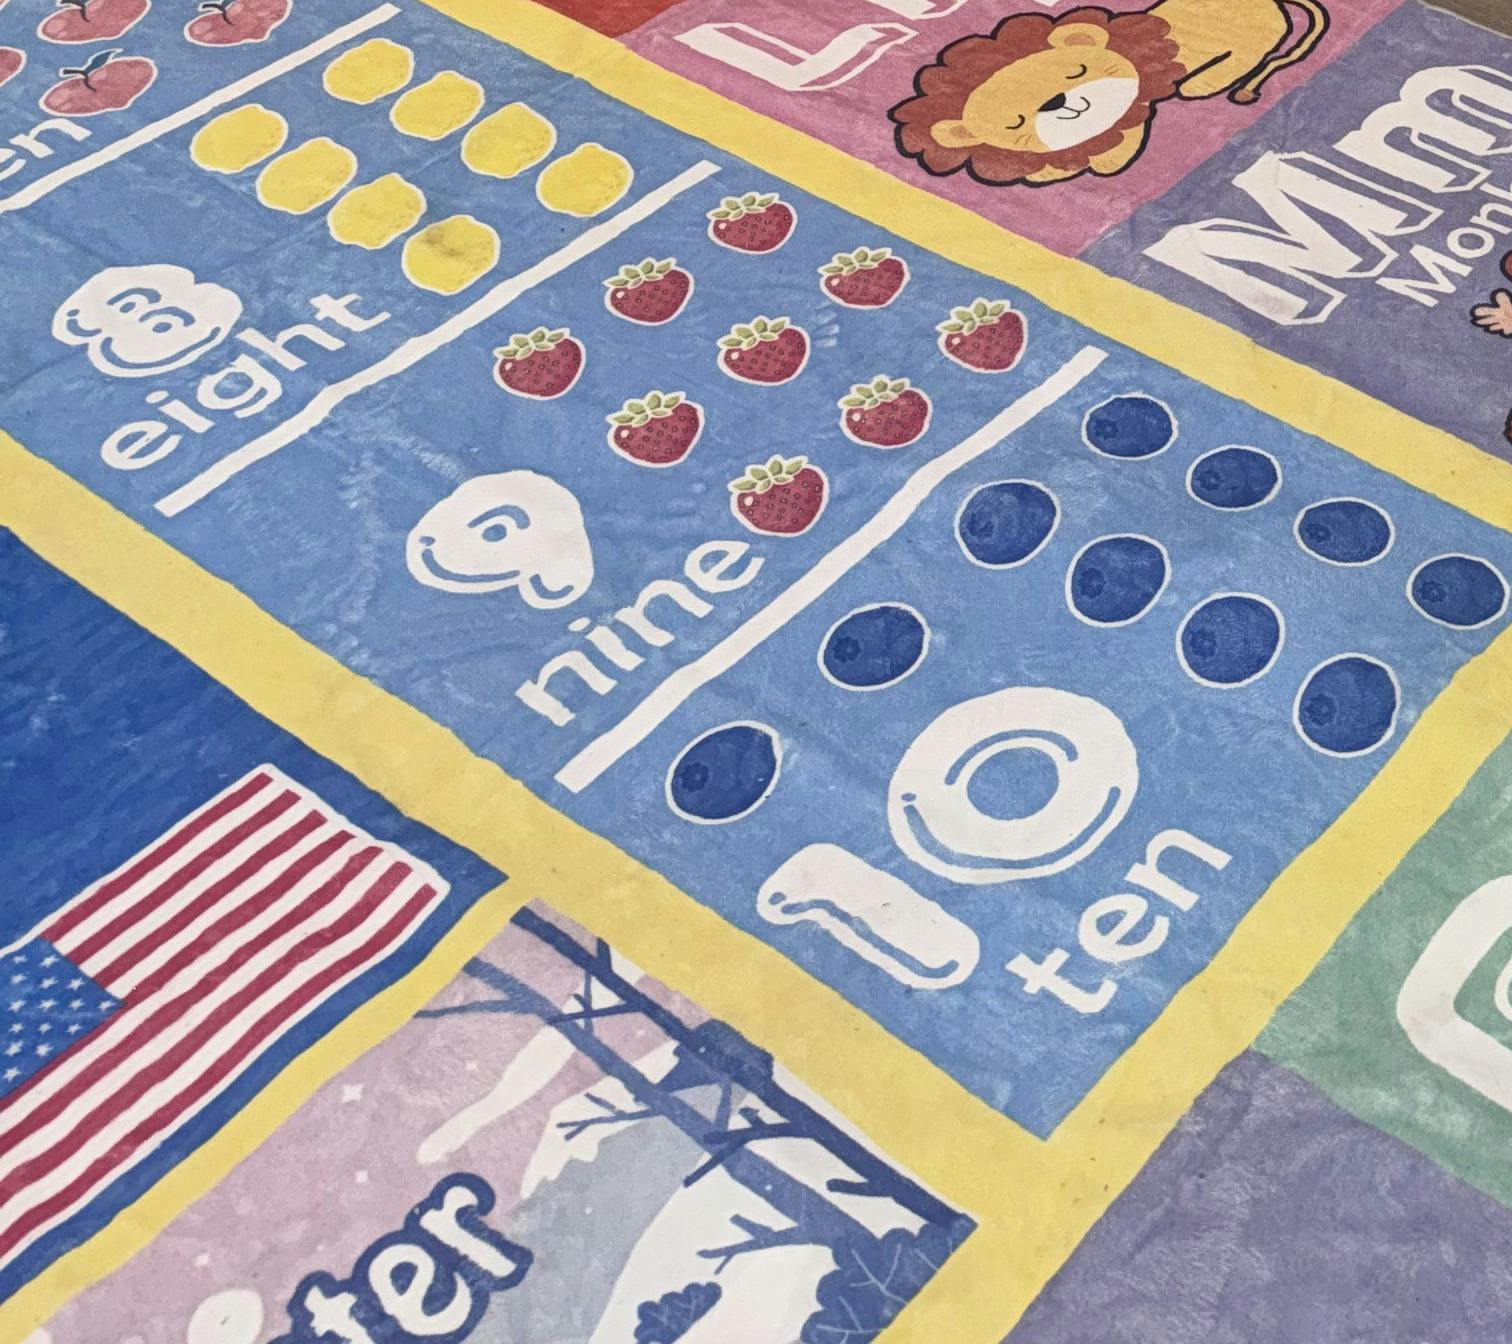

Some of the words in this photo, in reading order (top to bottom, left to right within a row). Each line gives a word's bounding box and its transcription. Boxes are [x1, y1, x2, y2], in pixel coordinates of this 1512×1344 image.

[52, 263, 243, 378] 8
[100, 292, 392, 470] eight
[406, 469, 594, 609] 9
[515, 539, 764, 727] nine
[757, 685, 1139, 990] 10
[1006, 827, 1233, 1015] ten
